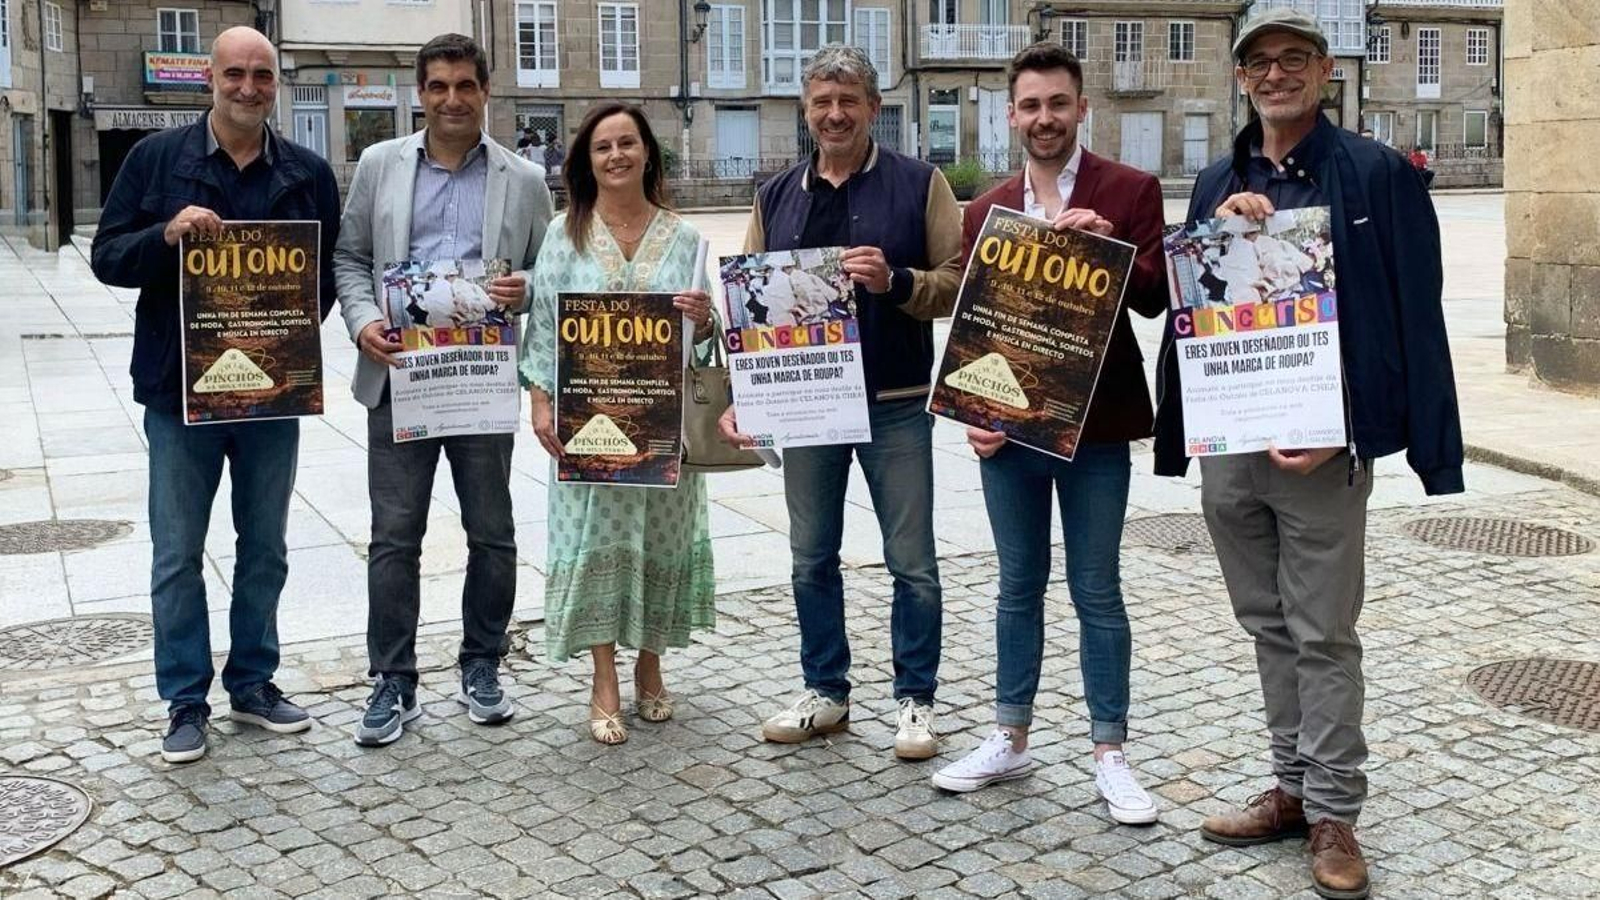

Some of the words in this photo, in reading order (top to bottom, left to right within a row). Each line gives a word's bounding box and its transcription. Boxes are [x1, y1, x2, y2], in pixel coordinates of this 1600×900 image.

[112, 112, 165, 127] ALMACENES
[242, 230, 262, 242] DO
[994, 217, 1038, 241] FESTA
[1044, 232, 1068, 248] DO
[187, 243, 306, 278] OUTONO
[980, 236, 1110, 297] OUTONO
[241, 310, 268, 318] SEMANA
[270, 309, 305, 317] COMPLETA
[565, 300, 606, 311] FESTA
[611, 300, 630, 312] DO
[1045, 294, 1056, 304] de
[1058, 300, 1095, 316] outubro
[260, 328, 289, 336] DIRECTO
[281, 318, 312, 326] SORTEOS
[562, 313, 672, 347] OUTONO
[994, 311, 1007, 321] FIN
[1008, 314, 1017, 324] DE
[1018, 318, 1048, 332] SEMANA
[1050, 327, 1089, 346] COMPLETA
[962, 312, 972, 321] DE
[1059, 342, 1094, 358] SORTEOS
[986, 330, 992, 338] E
[1020, 340, 1032, 351] EN
[1032, 344, 1065, 360] DIRECTO
[1185, 344, 1208, 360] ERES
[1210, 341, 1240, 357] XOVEN
[1242, 336, 1295, 354] DESEÑADOR
[1297, 334, 1310, 348] OU
[1312, 331, 1329, 346] TES
[735, 358, 754, 371] ERES
[1204, 360, 1230, 377] UNHA
[1232, 357, 1263, 374] MARCA
[1265, 356, 1276, 370] DE
[1279, 351, 1315, 369] ROUPA?
[647, 388, 676, 396] SORTEOS
[1188, 436, 1226, 444] CELANOVA
